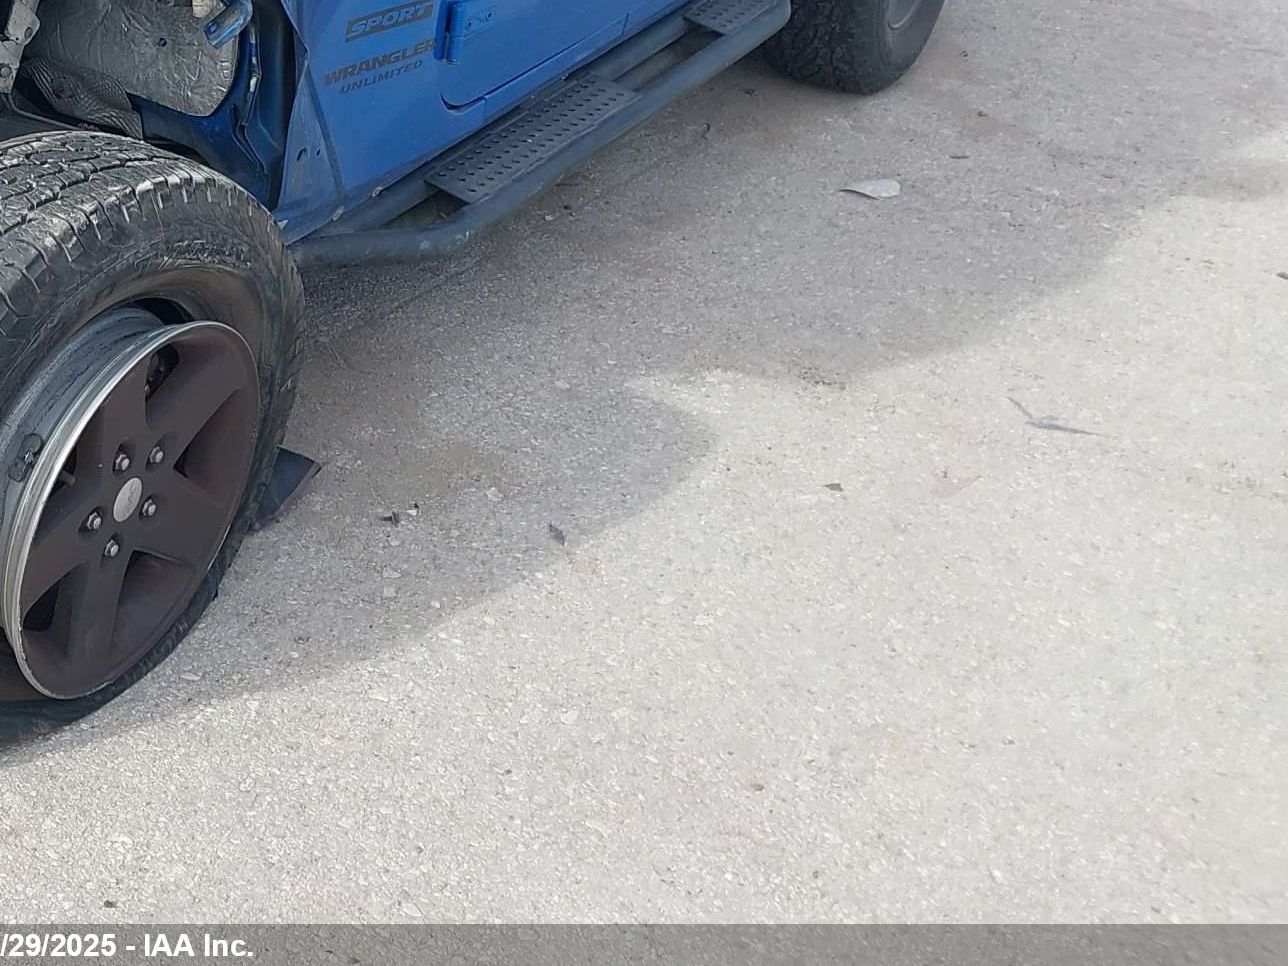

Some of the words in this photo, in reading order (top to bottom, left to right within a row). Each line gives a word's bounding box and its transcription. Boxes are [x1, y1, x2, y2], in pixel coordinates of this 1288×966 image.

[348, 0, 432, 37] SPORT
[325, 38, 435, 86] WRANGLER
[340, 60, 423, 94] UNLIMITED
